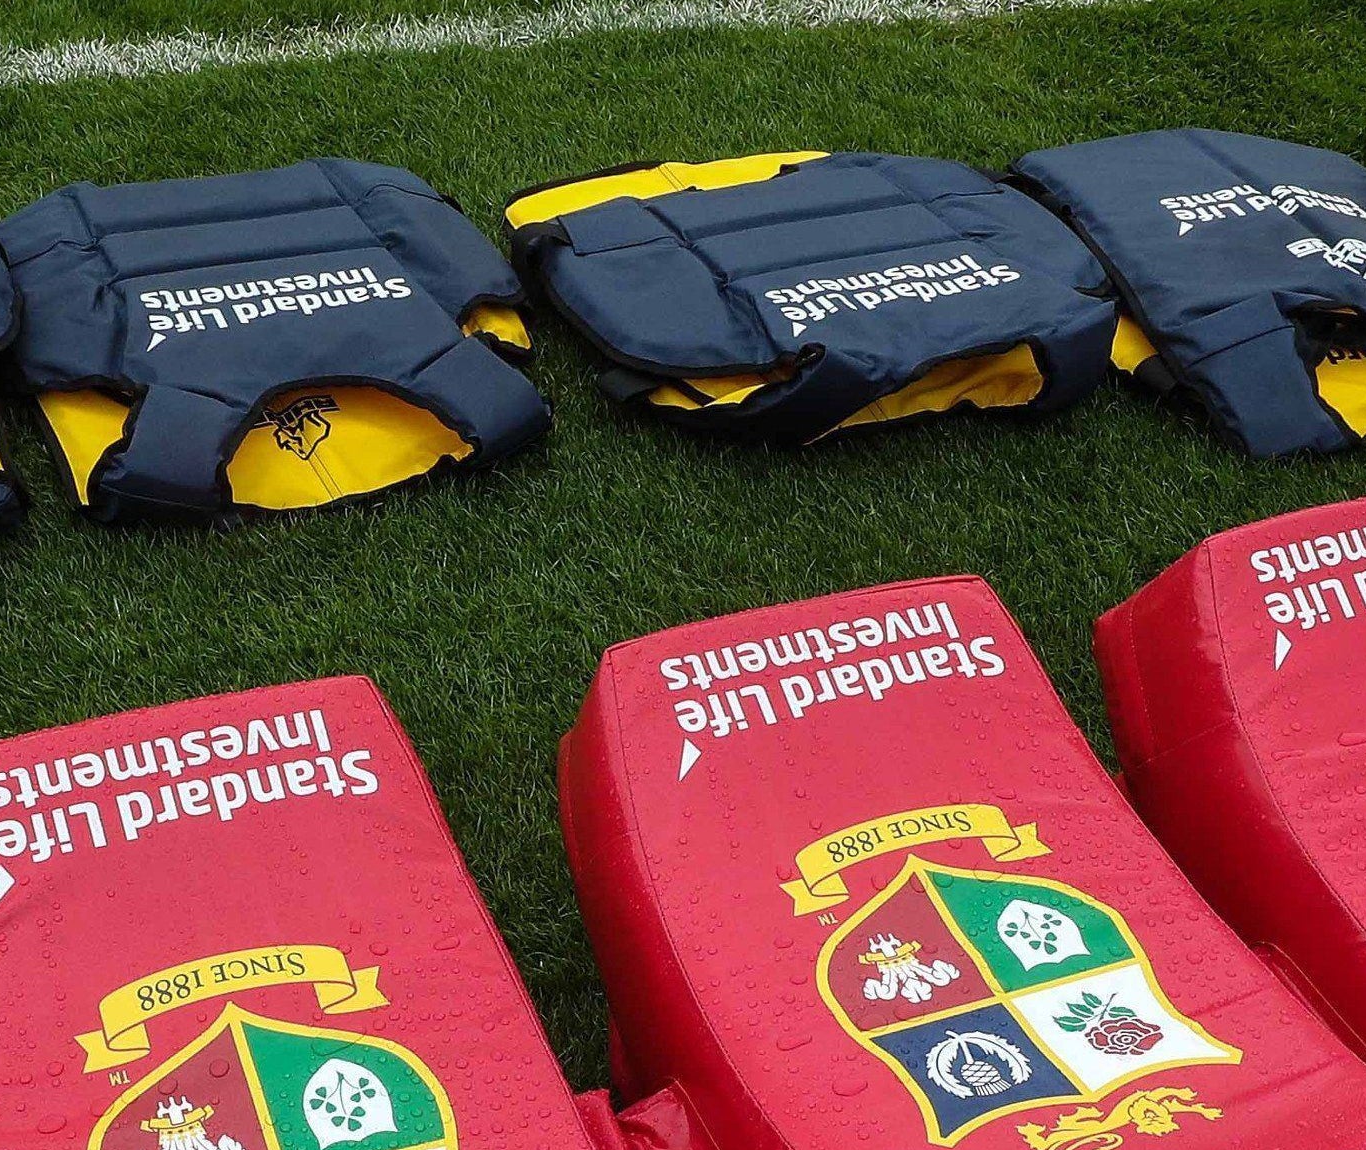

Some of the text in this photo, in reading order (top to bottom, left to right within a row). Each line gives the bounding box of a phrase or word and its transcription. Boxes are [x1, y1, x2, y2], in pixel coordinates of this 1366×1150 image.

[1173, 202, 1246, 222] Life
[139, 267, 379, 309] Investments
[149, 277, 412, 334] Standard Life
[764, 254, 983, 305] Investments
[781, 264, 1021, 321] Standard Life
[1264, 578, 1355, 630] Life
[659, 601, 960, 691] Investments
[673, 635, 1006, 738] Standard Life
[116, 749, 380, 842] Standard
[826, 827, 885, 863] 1888
[137, 969, 204, 1011] 1888
